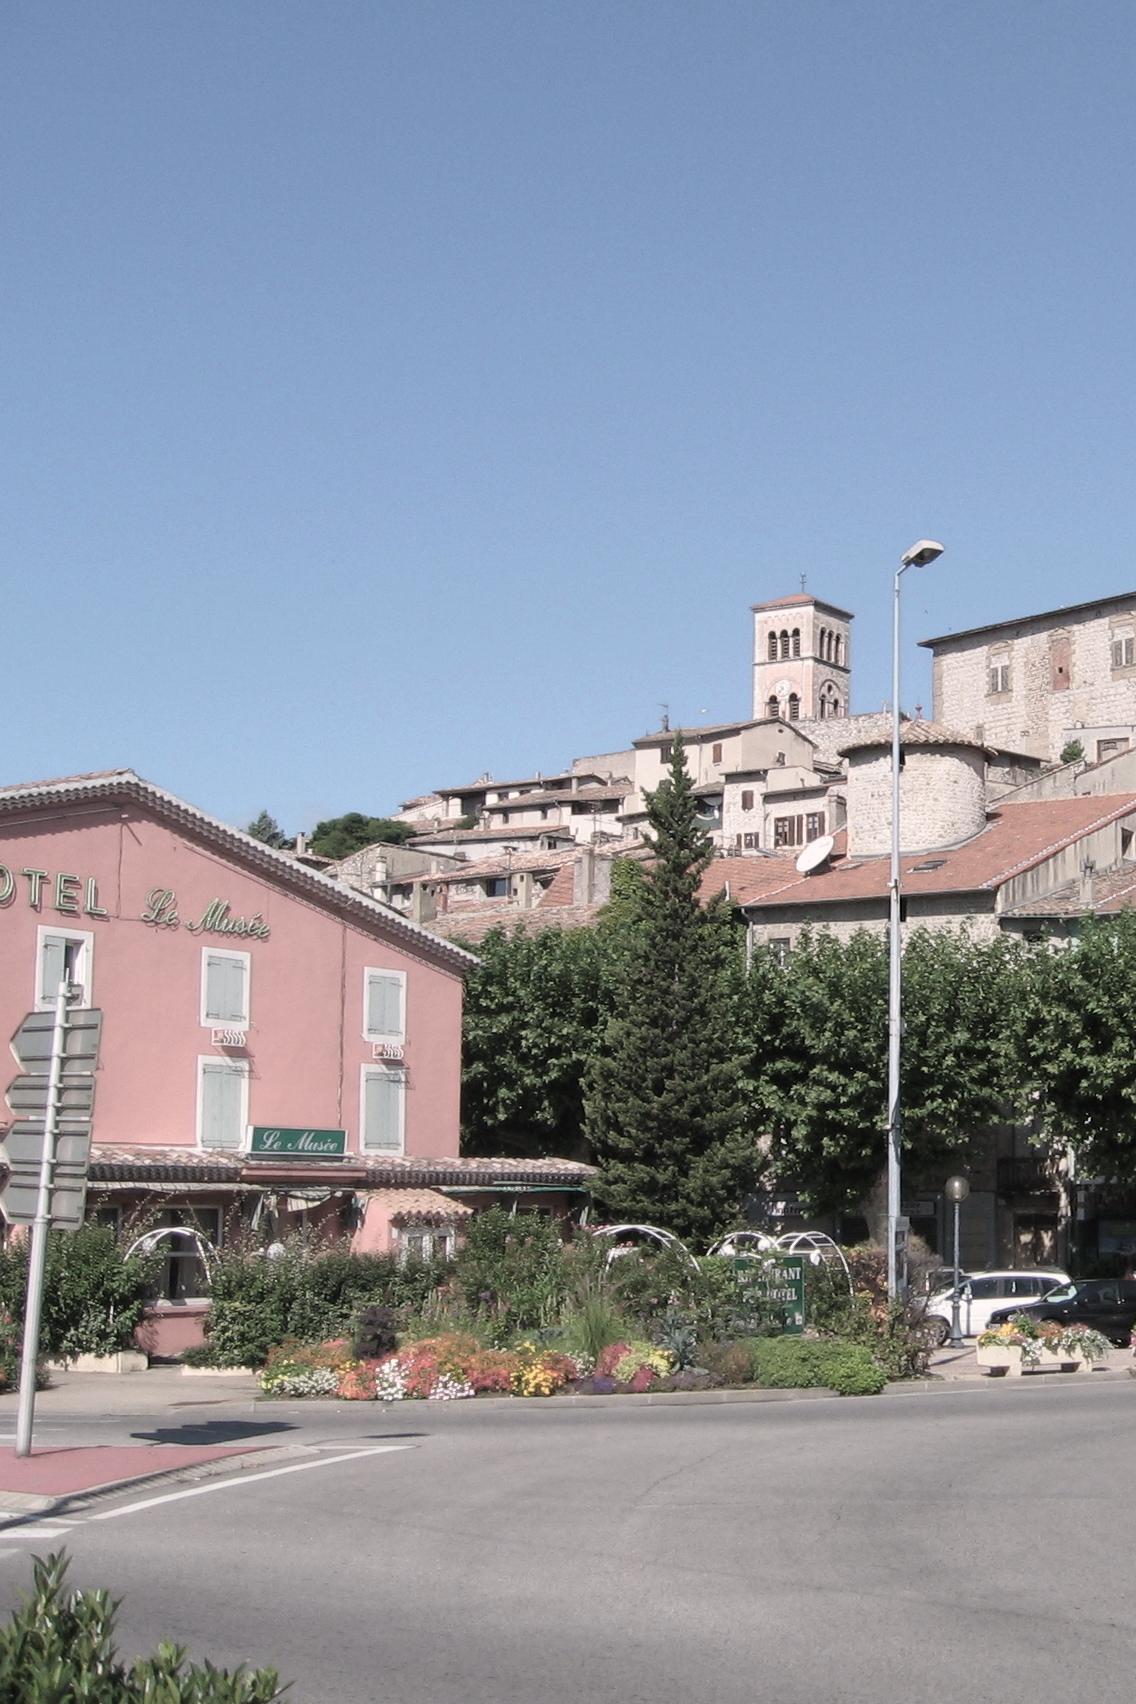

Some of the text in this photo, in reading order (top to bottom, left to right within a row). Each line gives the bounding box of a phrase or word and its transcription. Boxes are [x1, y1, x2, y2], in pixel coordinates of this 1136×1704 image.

[138, 888, 179, 925] Le
[186, 897, 270, 938] Musée
[260, 1129, 338, 1152] Le Musée
